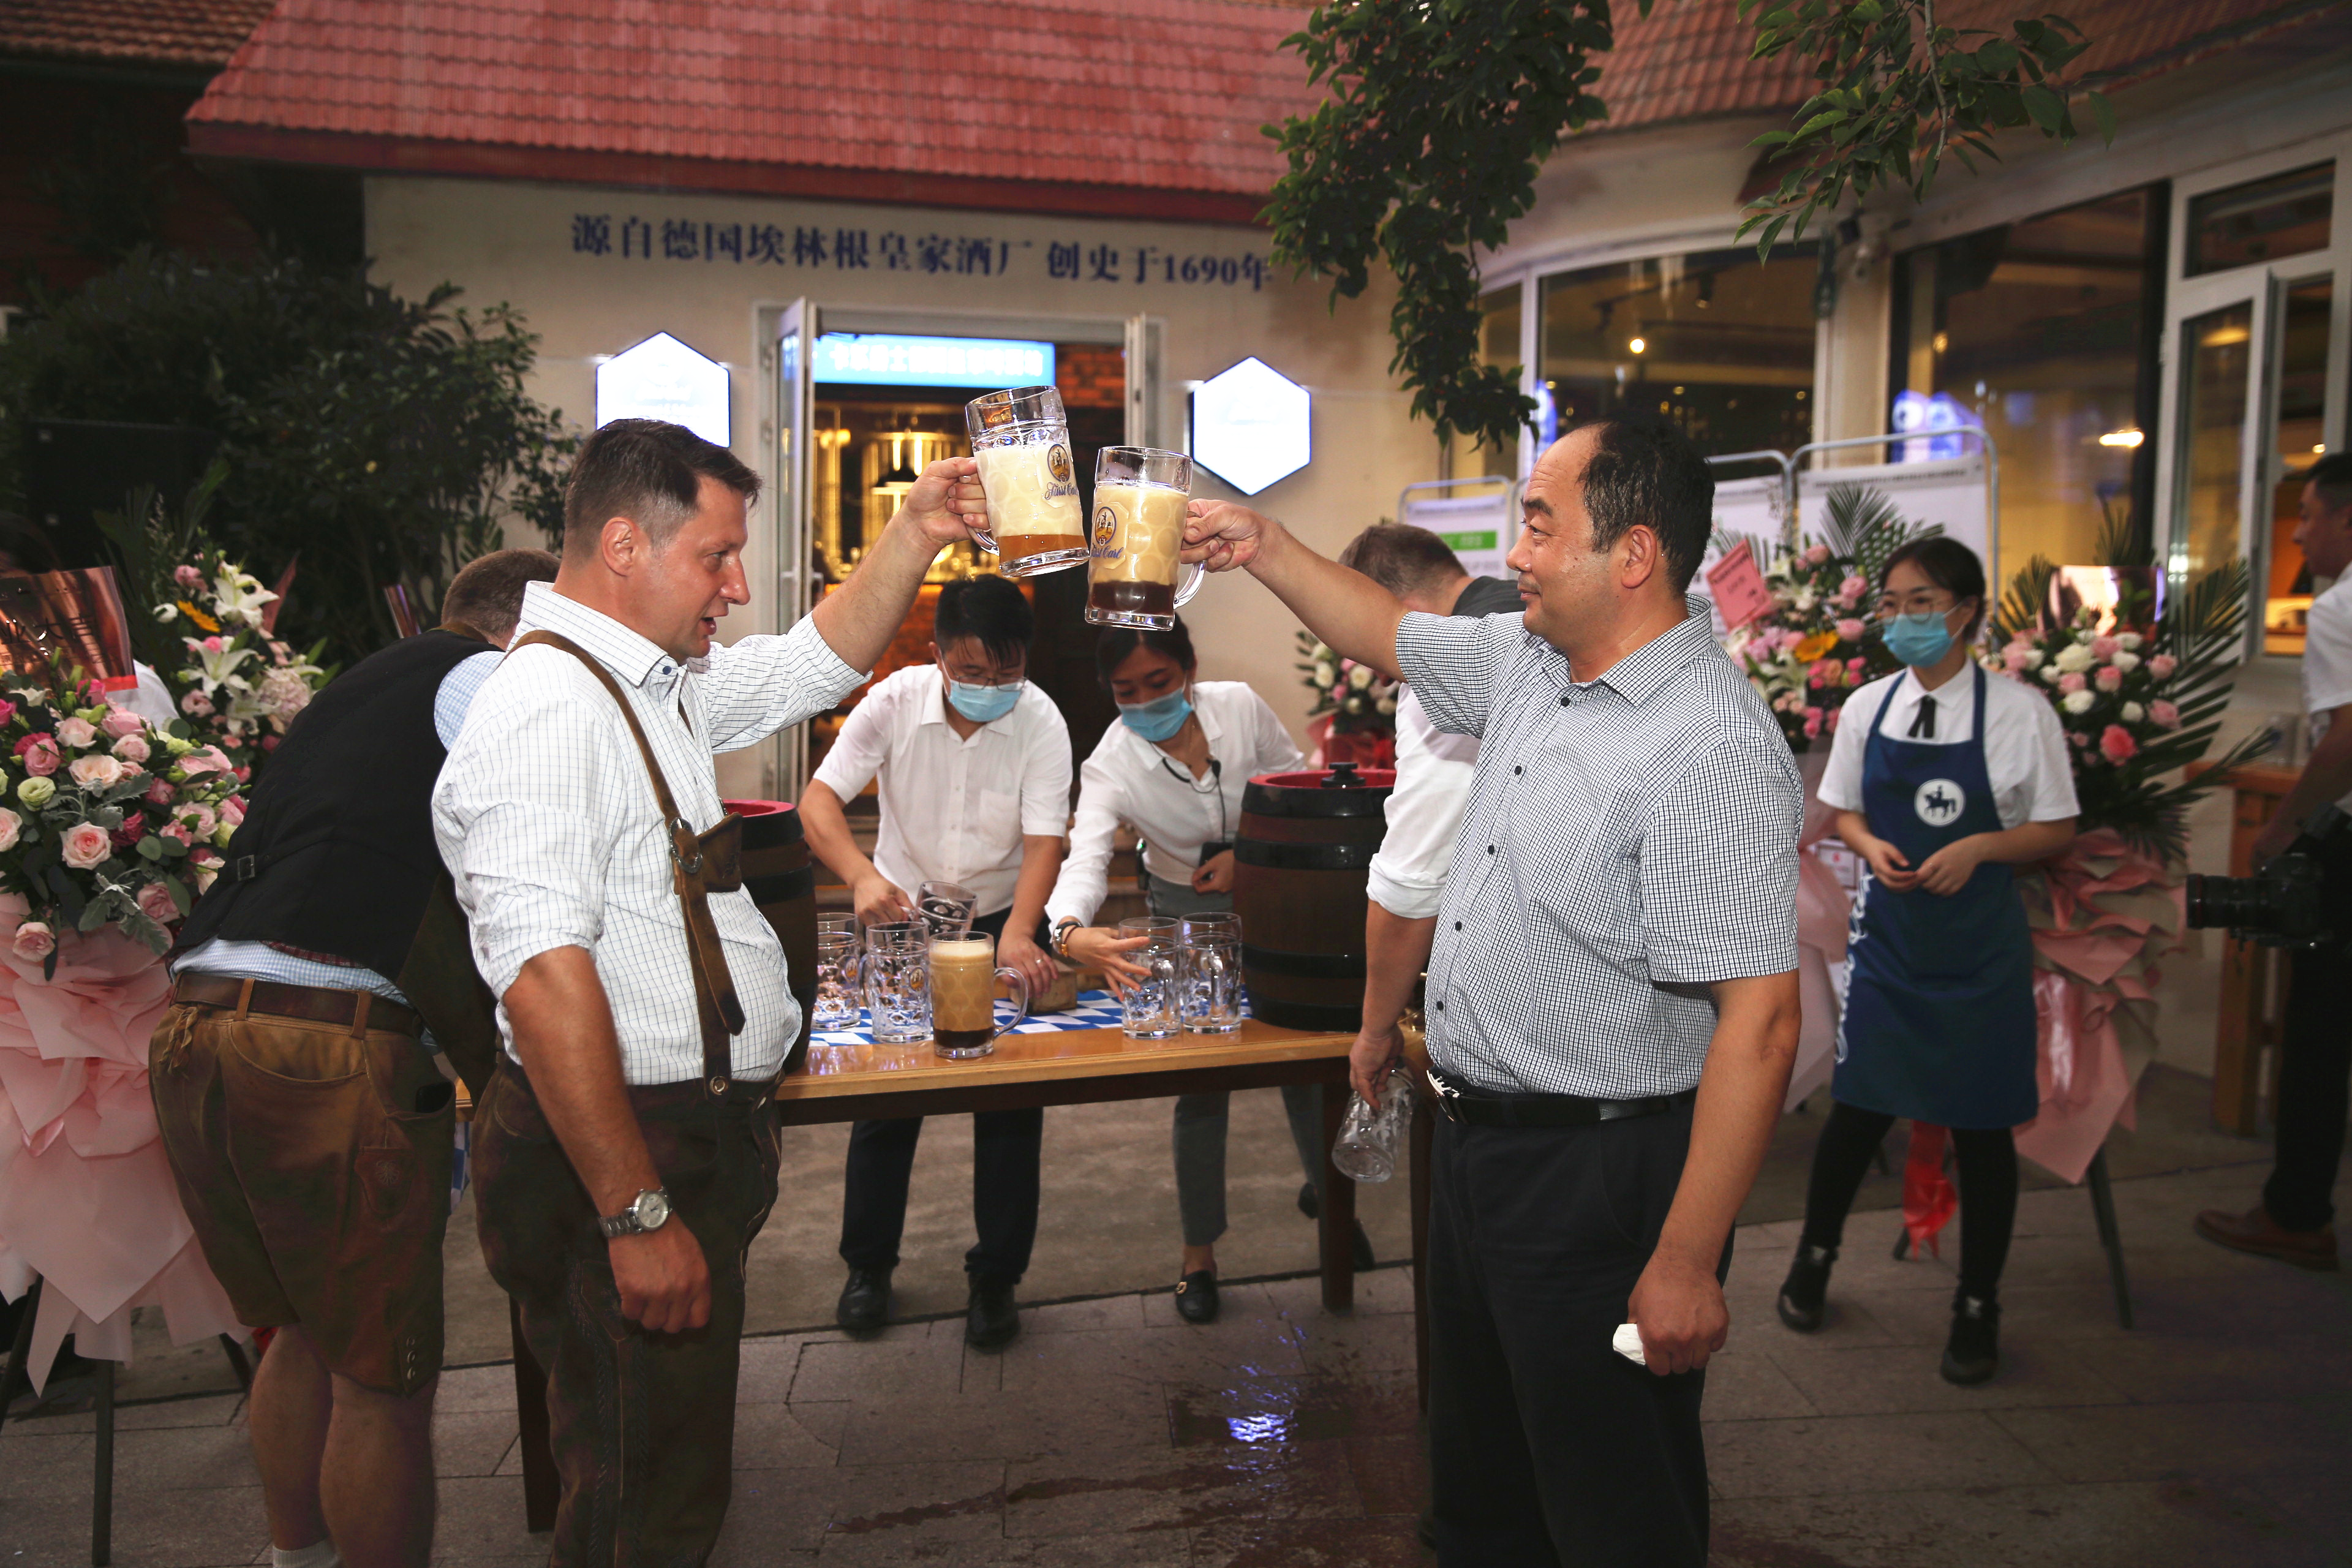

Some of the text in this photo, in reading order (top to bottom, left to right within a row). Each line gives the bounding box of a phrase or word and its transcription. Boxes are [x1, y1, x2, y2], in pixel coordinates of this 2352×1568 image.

[571, 213, 1273, 290] 源自德国埃林根皇家酒厂 创史于1690年
